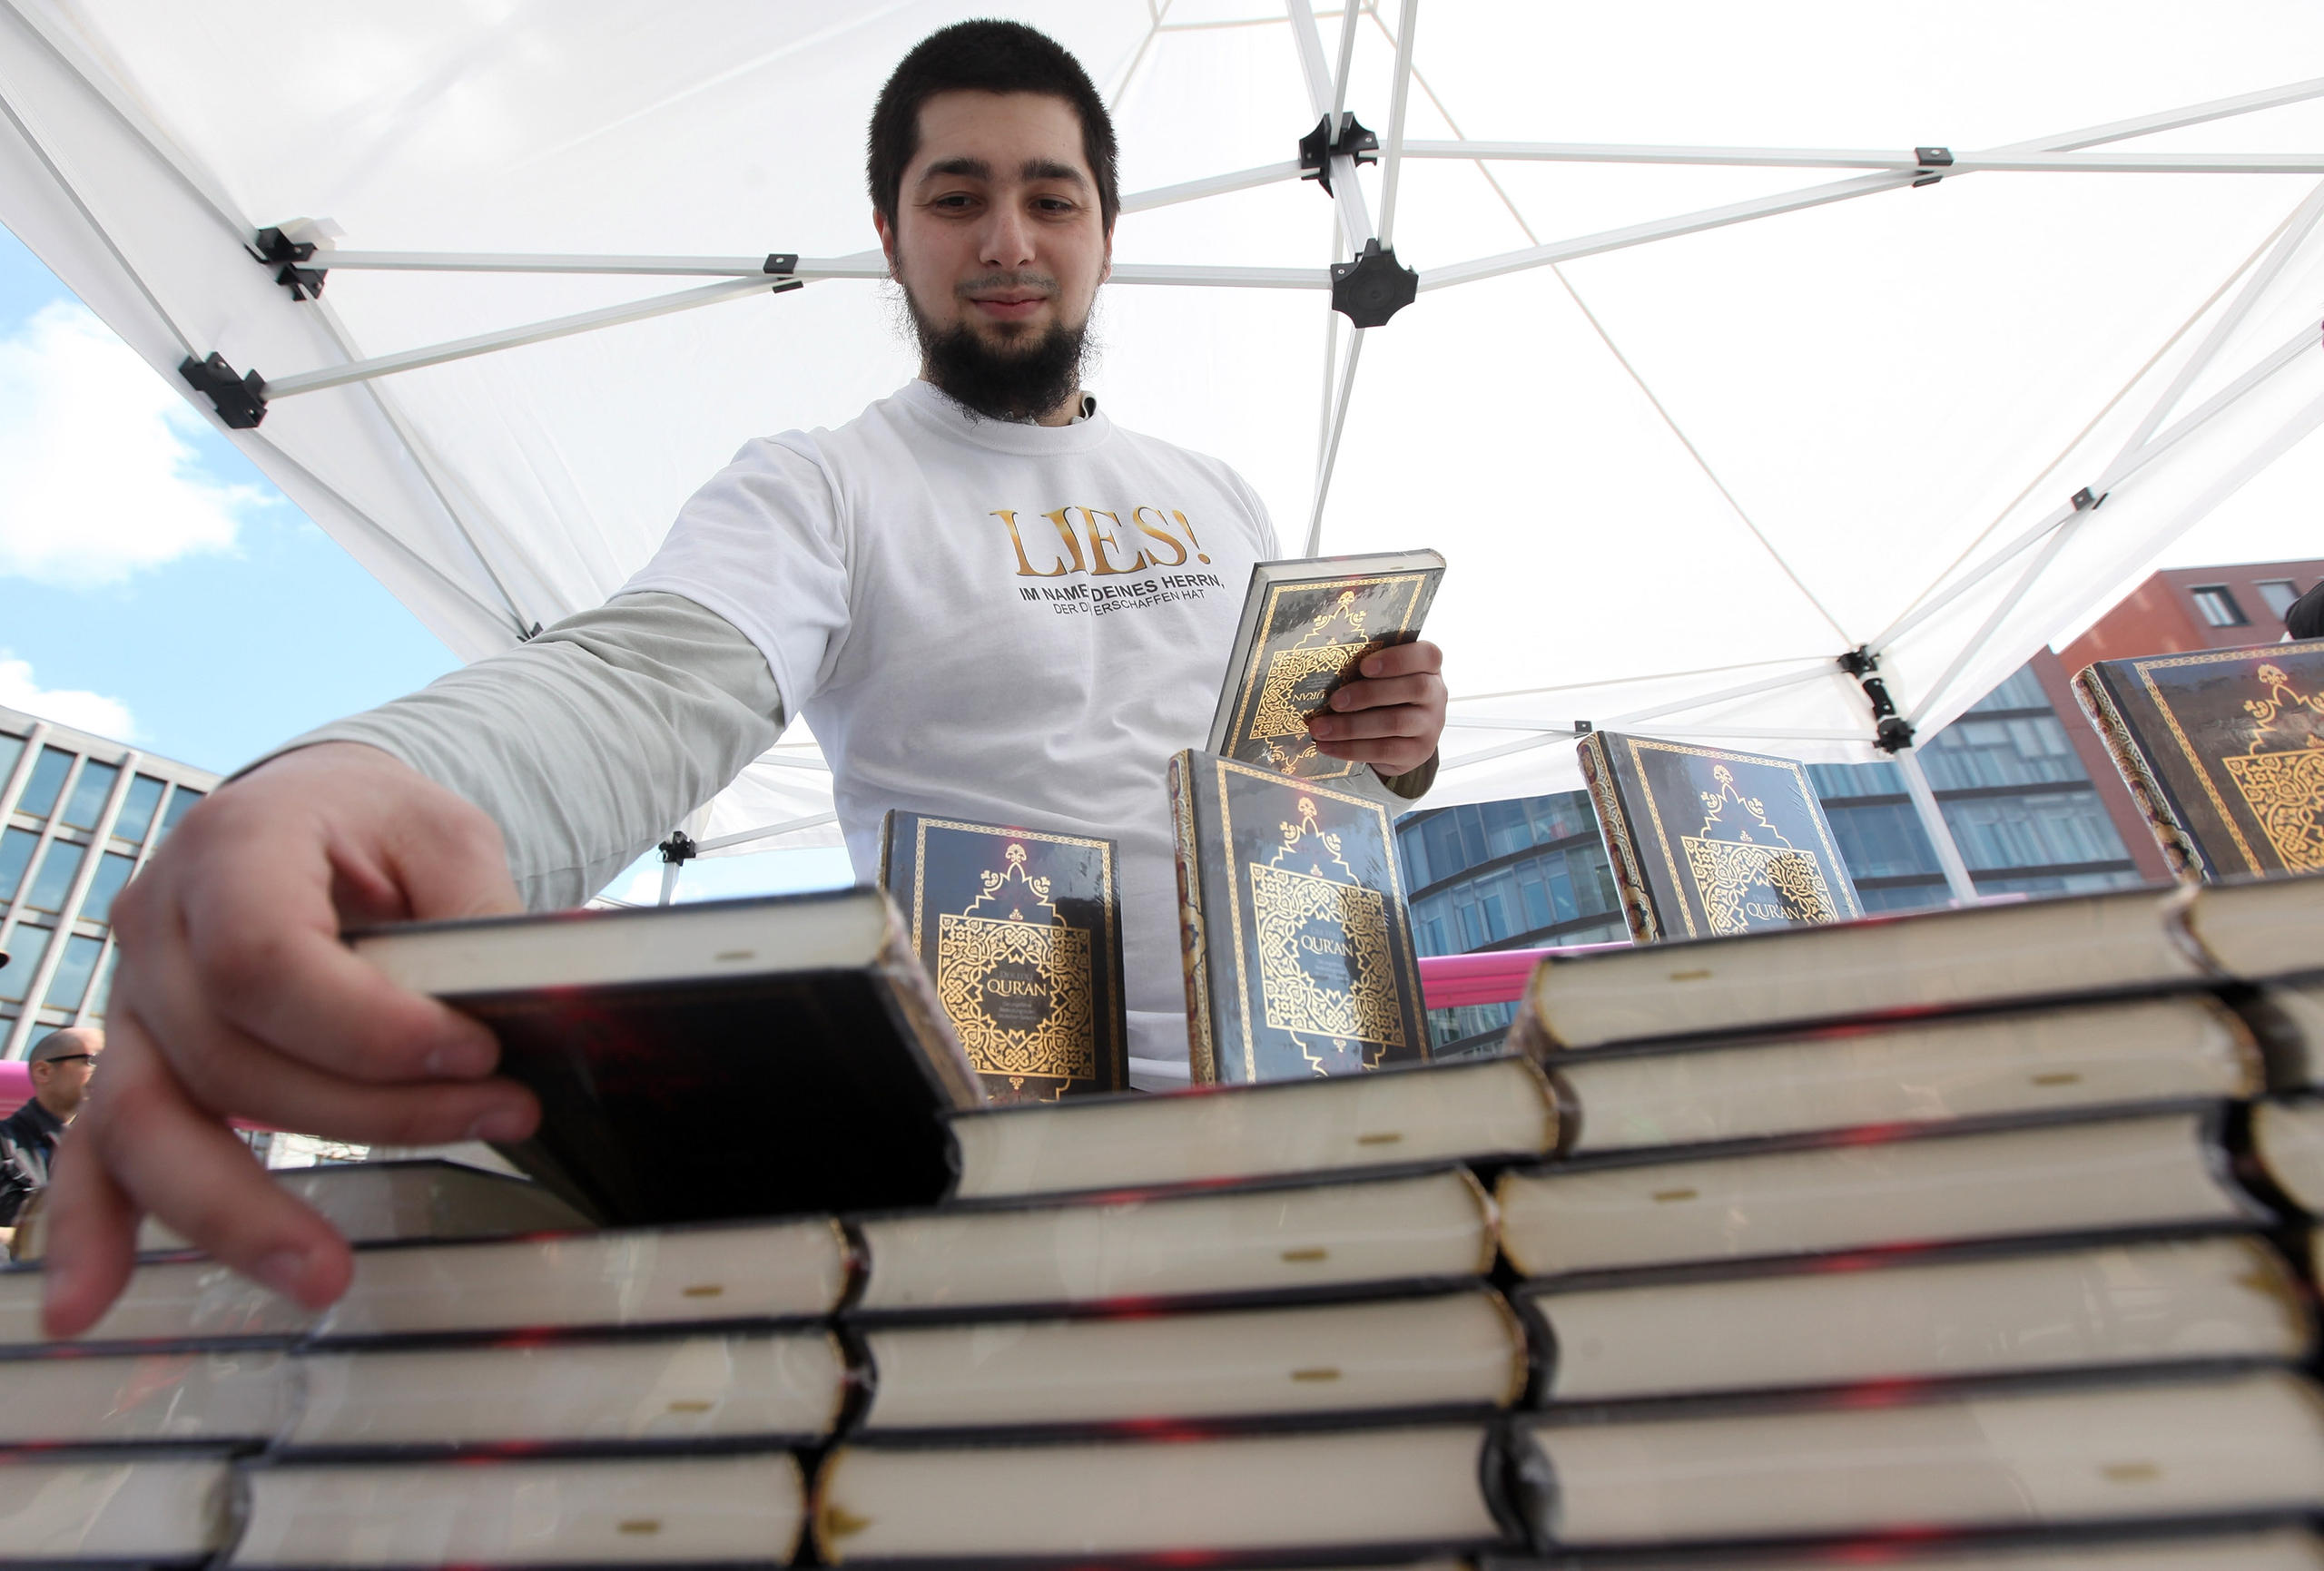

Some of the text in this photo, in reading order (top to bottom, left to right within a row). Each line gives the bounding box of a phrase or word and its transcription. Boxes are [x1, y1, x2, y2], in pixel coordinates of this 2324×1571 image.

[989, 506, 1211, 576] LIES!
[1019, 574, 1226, 603] IM NAME DEINES HERRN,
[1052, 603, 1078, 615] DER
[1093, 591, 1180, 616] ERSCHAFFEN
[1181, 588, 1206, 600] HAT
[1292, 689, 1327, 702] UR'AN
[1746, 902, 1802, 920] QUR'AN
[1300, 935, 1354, 957] QUR'AN
[987, 978, 1047, 997] QUR'AN
